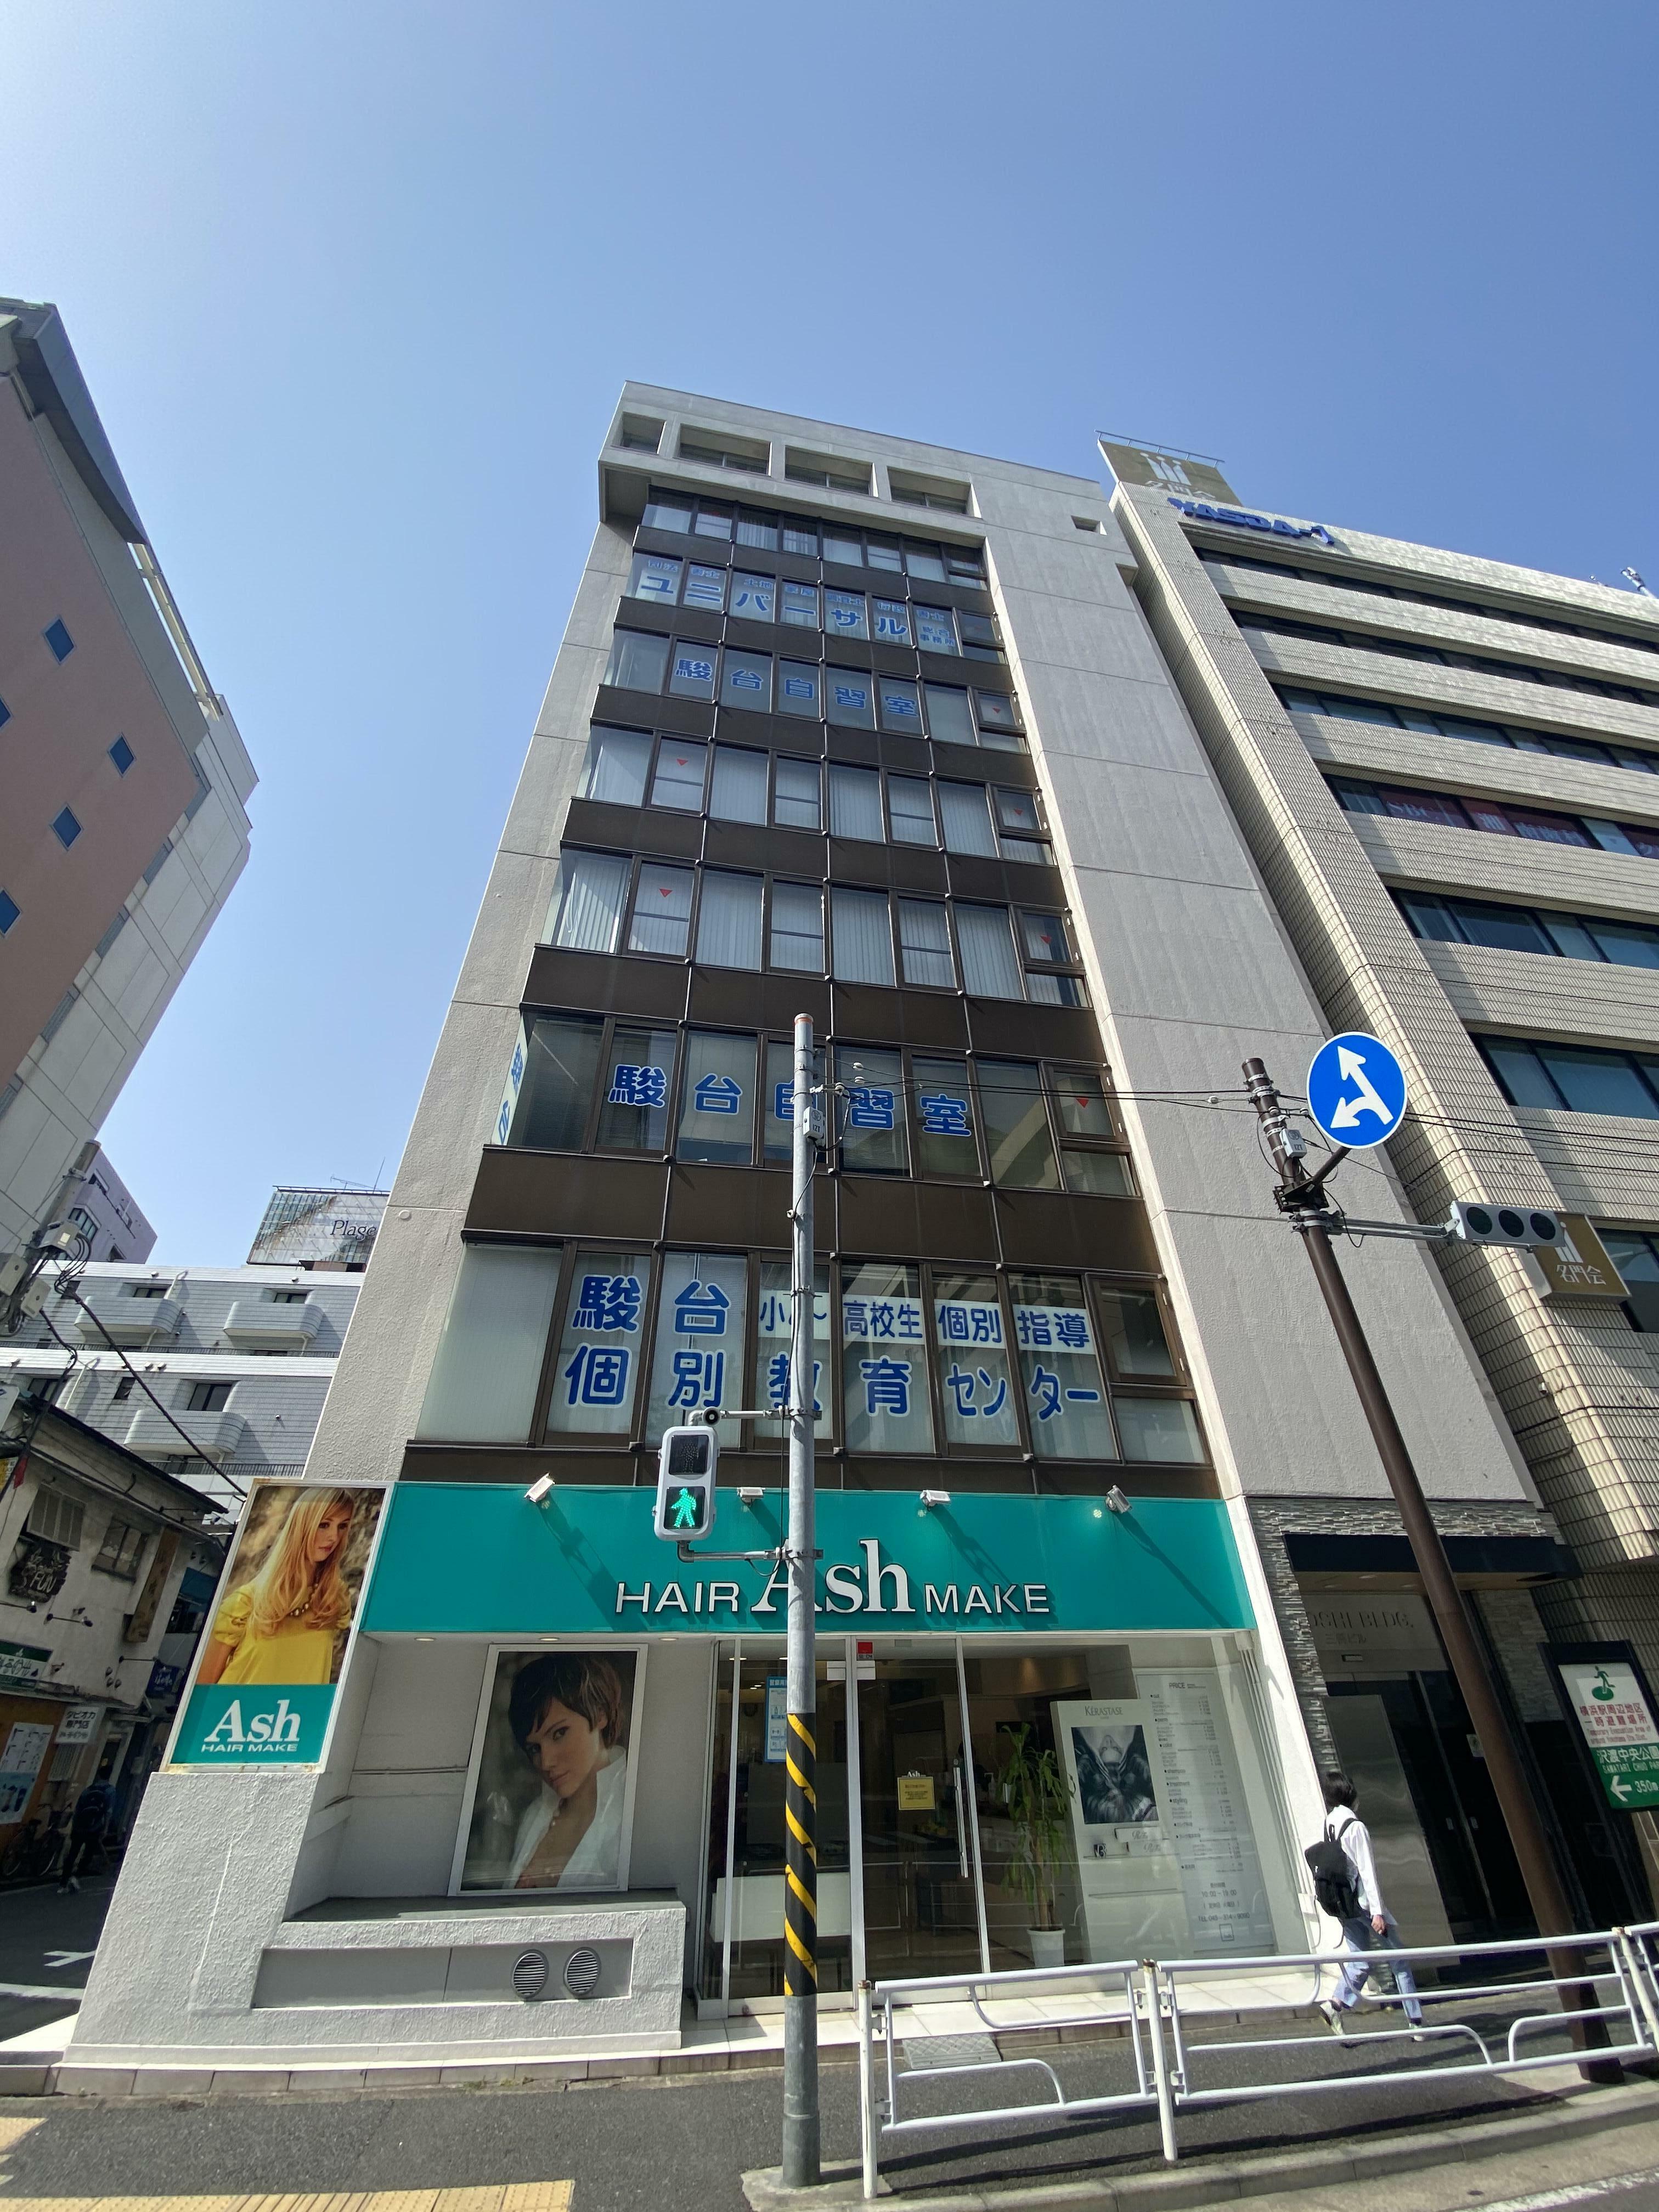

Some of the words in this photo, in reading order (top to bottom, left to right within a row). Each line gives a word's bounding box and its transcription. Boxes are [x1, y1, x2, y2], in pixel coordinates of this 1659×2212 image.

[640, 575, 908, 636] ユニバーサル
[674, 658, 918, 718] 駿台自習室
[571, 1274, 732, 1338] 駿台
[614, 1581, 741, 1613] HAIR
[924, 1583, 1051, 1614] MAKE
[203, 1699, 301, 1742] Ash
[201, 1743, 243, 1753] HAIR
[247, 1743, 298, 1752] MAKE
